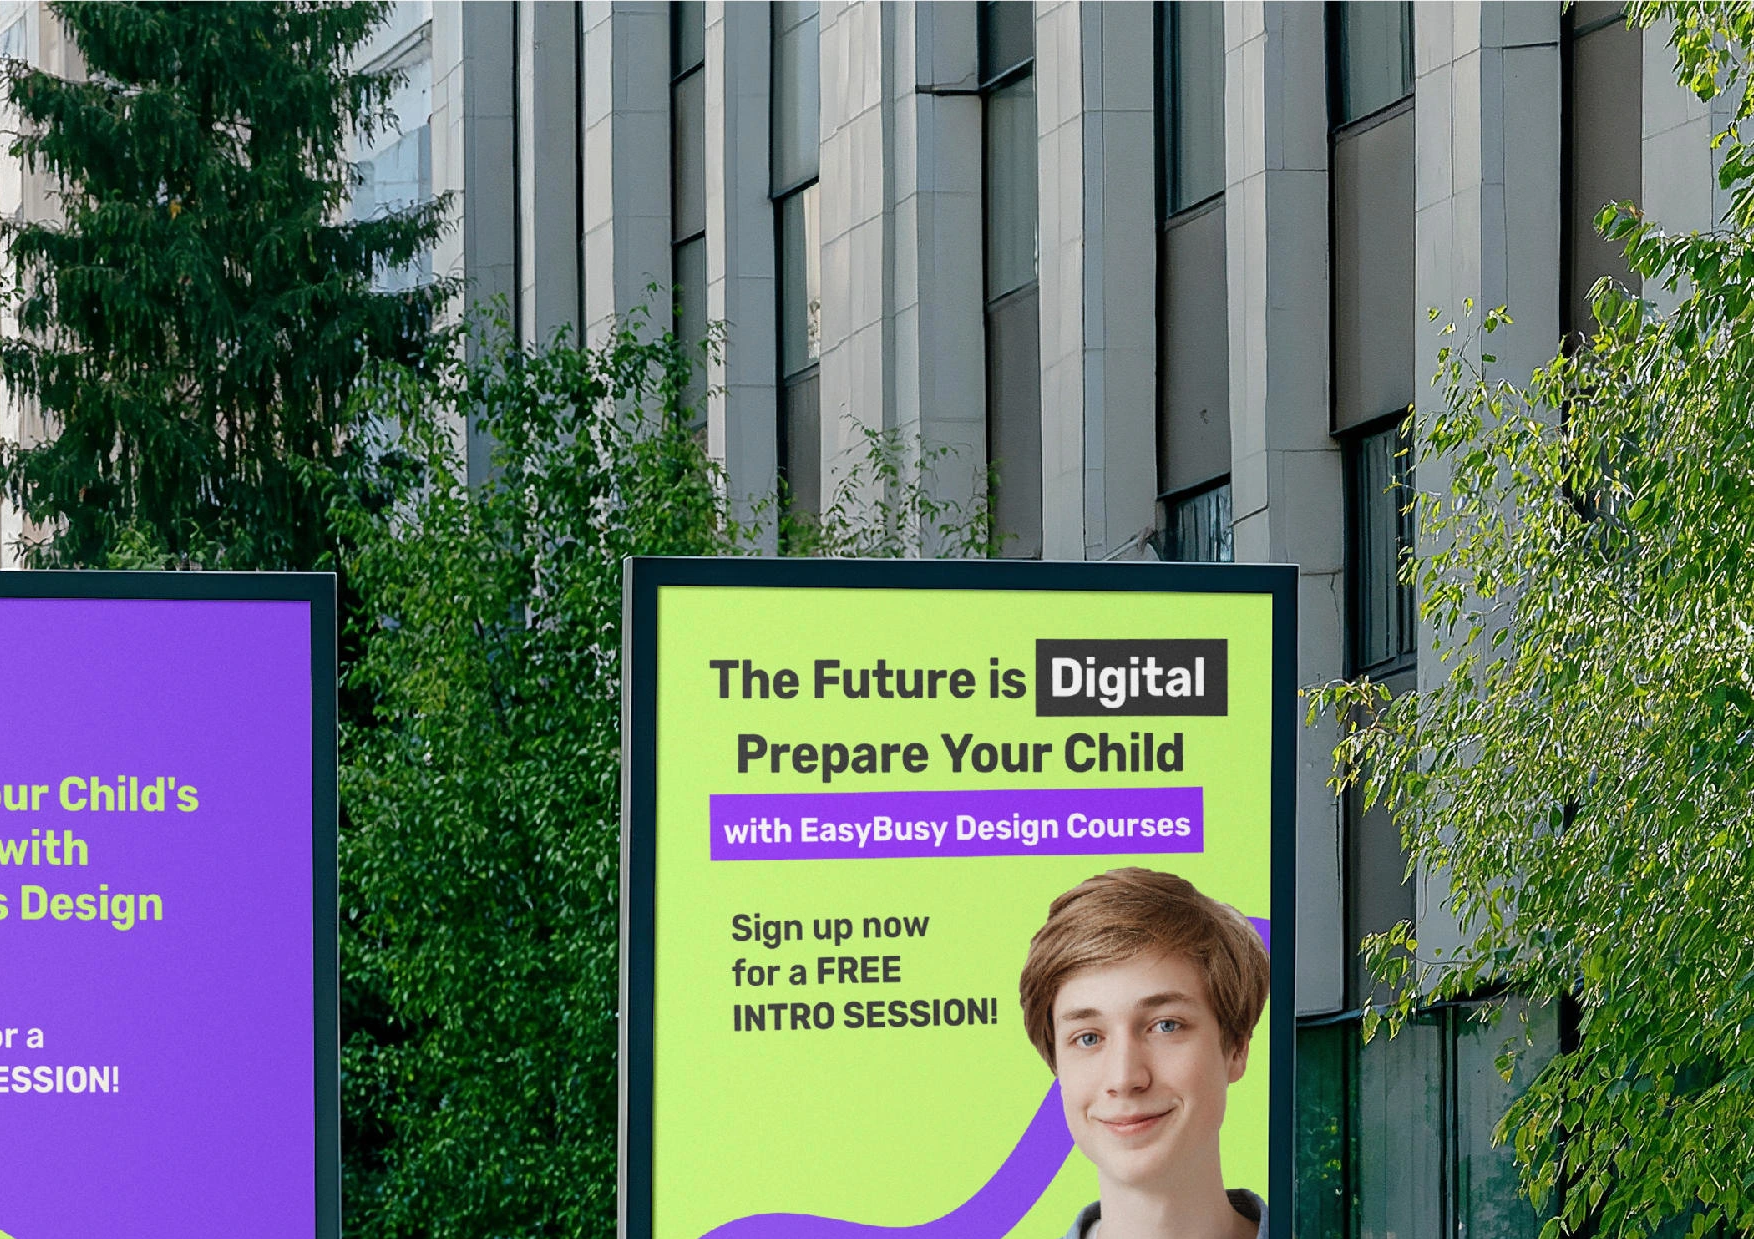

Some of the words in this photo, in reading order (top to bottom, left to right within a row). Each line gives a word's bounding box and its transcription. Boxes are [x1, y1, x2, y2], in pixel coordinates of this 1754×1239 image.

[710, 660, 799, 698] The
[814, 659, 976, 697] Future
[990, 657, 1026, 697] is
[1052, 657, 1204, 707] Digital
[738, 734, 928, 782] Prepare
[941, 734, 1052, 772] Your
[1065, 732, 1183, 772] Child
[60, 775, 198, 811] Child's
[724, 818, 791, 843] with
[801, 816, 948, 847] EasyBusy
[957, 813, 1058, 844] Design
[1067, 813, 1190, 837] Courses
[22, 884, 162, 930] Design
[732, 913, 803, 948] Sign
[814, 919, 853, 945] up
[864, 917, 929, 937] now
[732, 958, 780, 985] for
[789, 965, 806, 984] a
[818, 956, 900, 983] FREE
[734, 1002, 834, 1030] INTRO
[844, 998, 997, 1027] SESSION!
[27, 1028, 43, 1047] a
